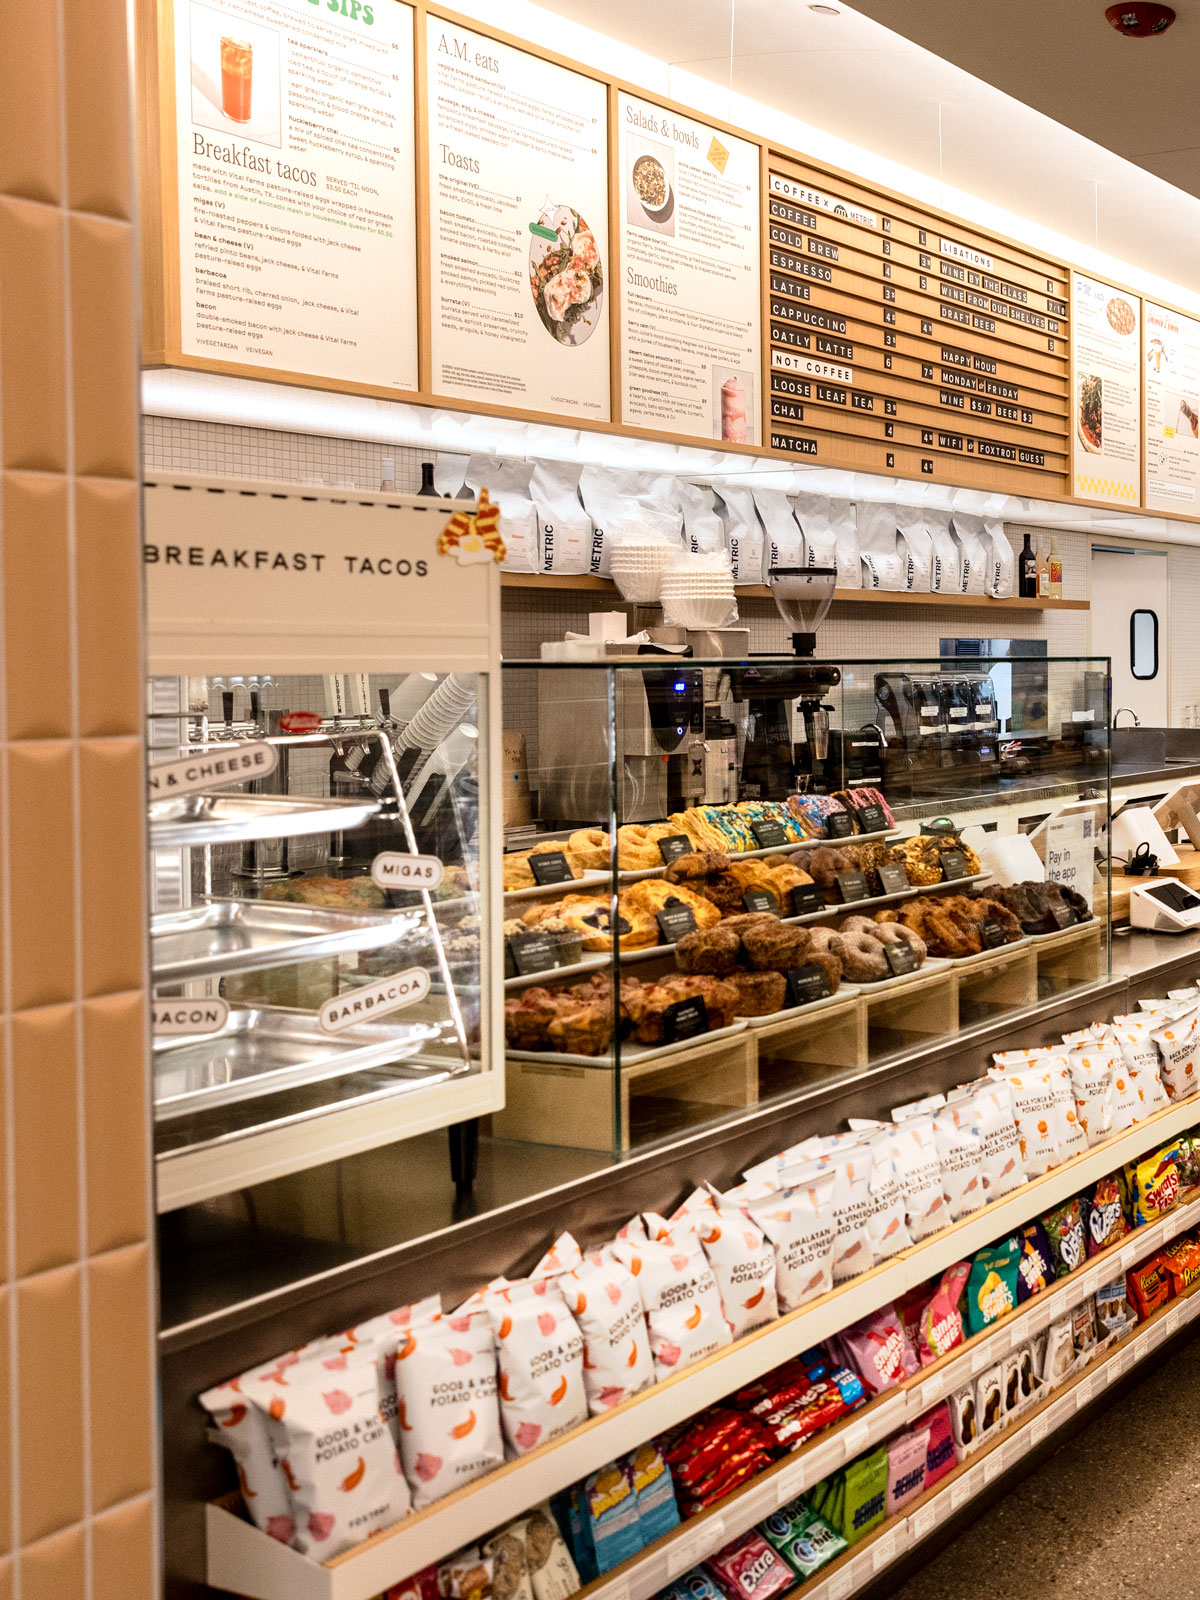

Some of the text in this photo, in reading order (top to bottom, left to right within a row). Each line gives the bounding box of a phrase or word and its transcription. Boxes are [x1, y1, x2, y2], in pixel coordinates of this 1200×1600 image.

[327, 0, 374, 25] SIPS
[437, 34, 499, 74] A.M. eats
[626, 105, 699, 149] Salads & bowls
[192, 132, 317, 187] Breakfast tacos
[440, 144, 480, 173] Toasts
[326, 175, 348, 186] SERVED
[326, 183, 357, 197] $3.50 EACH
[194, 196, 225, 209] migas (V)
[440, 209, 455, 217] bacon
[774, 180, 874, 227] COFFEE METRIC
[771, 204, 816, 228] COFFEE
[195, 231, 211, 240] bean
[219, 238, 242, 247] cheese
[244, 241, 254, 250] (V)
[772, 230, 839, 260] COLD BREW
[195, 242, 218, 252] refried
[220, 248, 238, 257] pinto
[261, 256, 274, 264] jack
[306, 266, 320, 274] Vital
[461, 258, 478, 266] salmon
[773, 255, 831, 281] ESPRESSO
[944, 243, 991, 268] LIBATIONS
[195, 267, 227, 279] barbacoa
[627, 267, 678, 296] Smoothies
[942, 264, 1027, 302] WINE BY THE GLASS
[441, 296, 461, 305] burrata
[773, 279, 809, 299] LATTE
[196, 301, 216, 310] bacon
[942, 286, 1058, 332] WINE FROM OUR SHELVES MP
[773, 305, 846, 332] CAPPUCCINO
[942, 308, 995, 332] DRAFT BEER
[773, 330, 852, 358] OATLY LATTE
[776, 355, 849, 380] NOT COFFEE
[943, 352, 996, 373] HAPPY HOUR
[774, 379, 873, 409] LOOSE LEAF TEA
[943, 373, 1018, 399] MONDAY FRIDAY
[774, 404, 801, 418] CHAI
[941, 394, 964, 407] WINE
[998, 407, 1017, 419] BEER
[1023, 413, 1032, 423] $3
[772, 437, 817, 453] MATCHA
[940, 437, 1044, 464] WIFI FOXTROT GUEST
[544, 524, 553, 570] METRIC
[590, 528, 604, 572] METRIC
[731, 538, 739, 579] METRIC
[144, 545, 429, 577] BREAKFAST TACOS
[962, 559, 970, 592] METRIC
[167, 773, 179, 787] &
[186, 751, 265, 782] CHEESE
[1049, 848, 1070, 865] Pay in
[383, 863, 434, 878] MIGAS
[1049, 867, 1076, 881] the app
[329, 978, 421, 1024] BARBACOA
[1021, 1104, 1041, 1114] POTATO
[788, 1255, 815, 1271] POTATO
[659, 1289, 695, 1310] POTATO
[660, 1278, 698, 1301] GOOD &
[432, 1378, 476, 1394] GOOD &
[430, 1391, 471, 1407] POTATO
[316, 1421, 362, 1449] GOOD &
[315, 1438, 359, 1463] POTATO
[791, 1528, 833, 1564] Orbit
